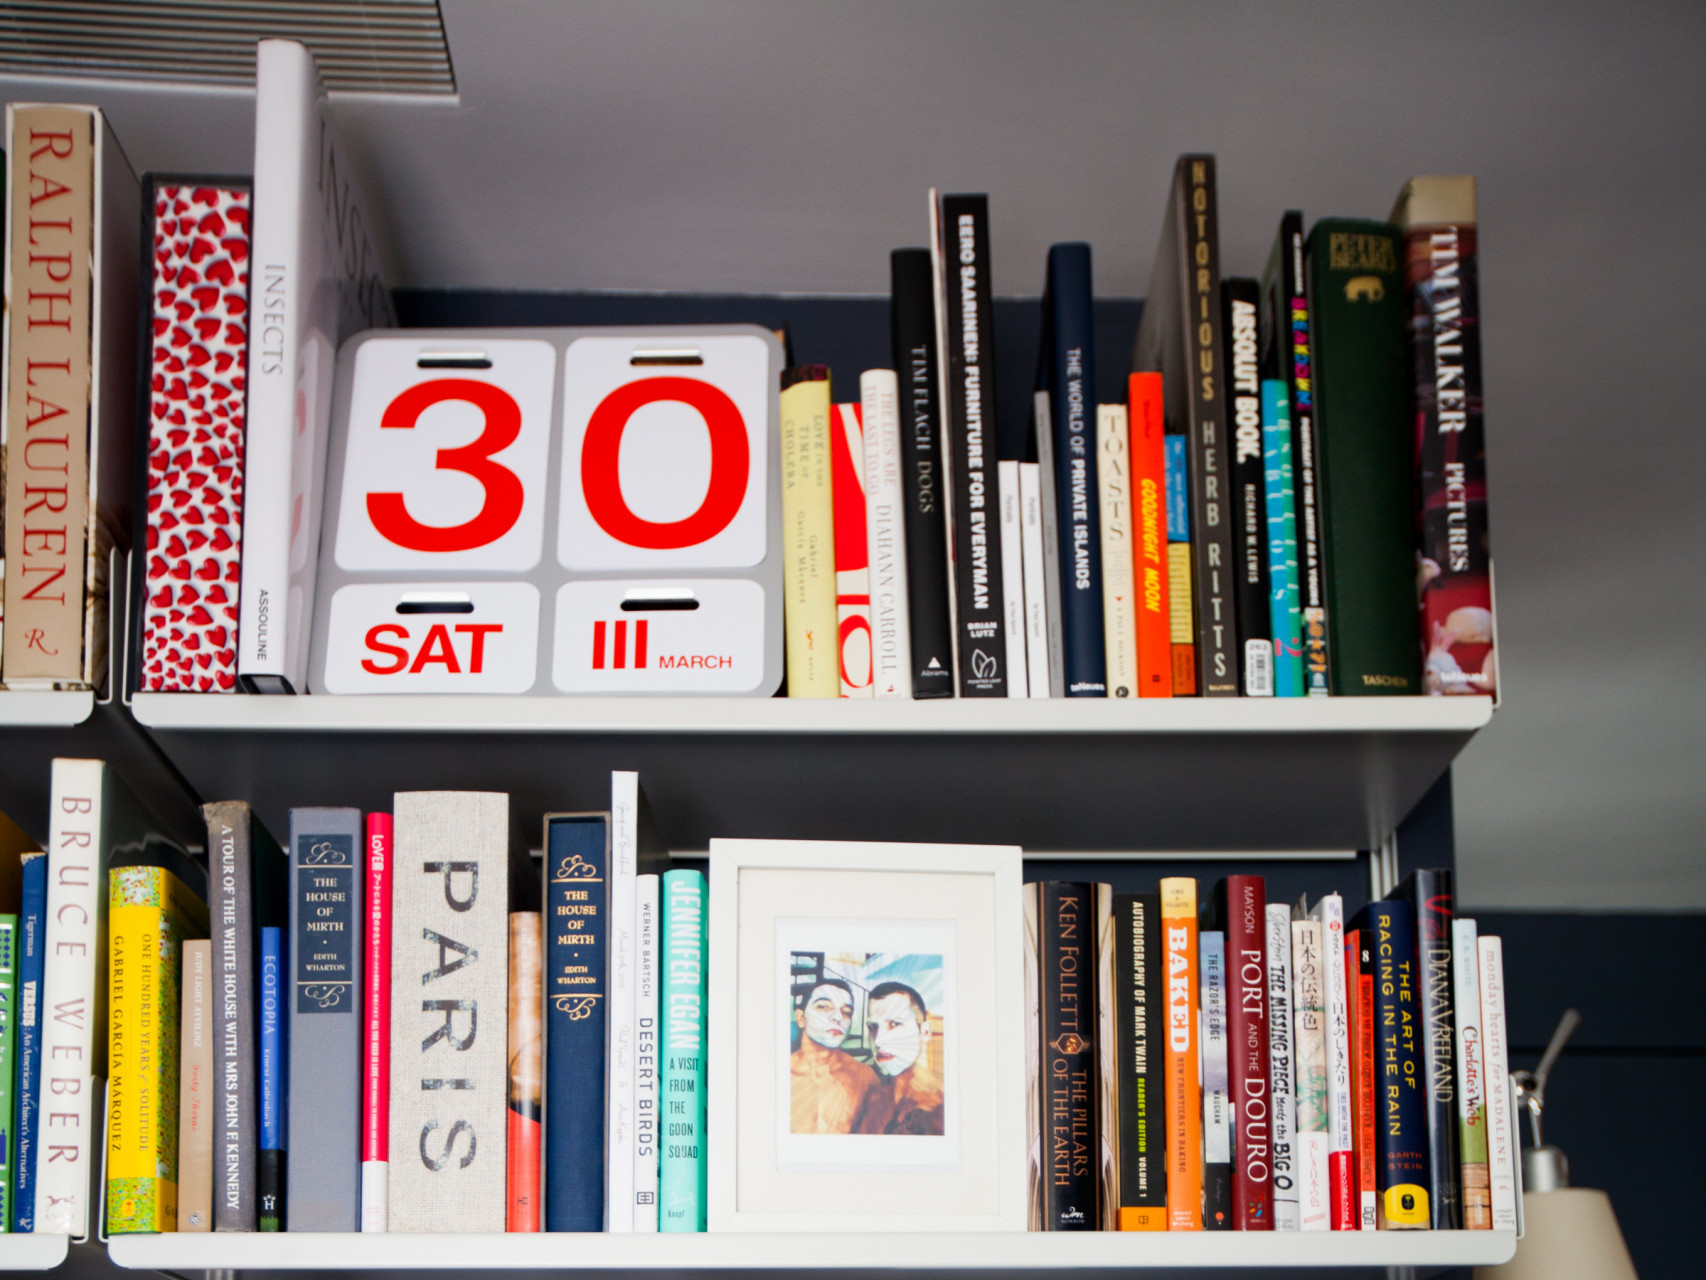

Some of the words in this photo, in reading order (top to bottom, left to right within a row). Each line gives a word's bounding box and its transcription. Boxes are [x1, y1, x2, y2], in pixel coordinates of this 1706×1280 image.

[27, 128, 74, 333] RALPH
[959, 215, 975, 263] EERO
[1429, 227, 1460, 287] TIM
[1192, 160, 1215, 400] NOTORIOUS
[261, 263, 286, 376] INSECTS
[961, 266, 978, 361] SAARINEN:
[911, 345, 927, 383] TIM
[1067, 348, 1082, 377] THE
[1233, 300, 1257, 392] ABSOLUT
[1432, 299, 1466, 434] WALKER
[913, 389, 930, 449] FLACH
[965, 367, 982, 467] FURNITURE
[1068, 380, 1083, 432] WORLD
[1071, 437, 1084, 456] OF
[1236, 397, 1259, 463] BOOK.
[21, 358, 70, 606] LAUREN
[917, 461, 934, 513] DOGS
[969, 472, 985, 507] FOR
[1072, 459, 1087, 520] PRIVATE
[1104, 415, 1123, 541] TOASTS
[1201, 421, 1220, 525] HERB
[1141, 478, 1159, 564] GOODNIGHT
[1444, 462, 1469, 571] PICTURES
[876, 505, 893, 586] DIAHANN
[971, 512, 989, 608] EVERYMAN
[1074, 525, 1090, 589] ISLANDS
[1144, 568, 1160, 612] MOON
[1208, 543, 1227, 676] RITTS
[257, 589, 269, 660] ASSOULINE
[591, 619, 648, 670] III
[659, 655, 734, 669] MARCH
[879, 594, 896, 674] CARROLL
[967, 621, 997, 630] BRIAN
[970, 629, 995, 638] LUTZ
[360, 623, 503, 675] SAT
[921, 668, 949, 676] Abrams
[1362, 675, 1408, 688] TASCHEN
[221, 825, 233, 835] A
[56, 797, 92, 957] BRUCE
[222, 837, 234, 874] TOUR
[223, 877, 234, 894] OF
[564, 890, 588, 900] THE
[223, 898, 235, 924] THE
[557, 905, 596, 915] HOUSE
[568, 921, 585, 930] OF
[642, 902, 651, 946] WERNER
[1059, 896, 1078, 938] KEN
[1244, 887, 1255, 934] MAYSON
[140, 933, 153, 961] ONE
[224, 927, 236, 970] WHITE
[558, 935, 595, 945] MIRTH
[669, 880, 701, 985] JENNIFER
[1132, 901, 1145, 986] AUTOBIOGRAPHY
[113, 935, 124, 1003] GABRIEL
[564, 965, 588, 973] EDITH
[642, 950, 651, 997] BARTSCH
[1208, 954, 1218, 971] THE
[1379, 915, 1396, 996] RACING
[139, 965, 152, 1027] HUNDRED
[224, 974, 237, 1017] HOUSE
[263, 955, 277, 1034] ECOTOPIA
[1060, 946, 1080, 1027] FOLLETT
[1134, 990, 1145, 1002] OF
[1168, 926, 1190, 1053] BAKED
[1209, 974, 1220, 1015] RAZOR'S
[1241, 949, 1264, 1019] PORT
[1270, 965, 1285, 992] THE
[1301, 930, 1318, 1032] 日本の伝統色
[1399, 961, 1412, 1003] THE
[1428, 949, 1452, 1009] DIANA
[419, 861, 479, 1172] PARIS
[669, 994, 701, 1049] EGAN
[1134, 1006, 1146, 1037] MARK
[1210, 1018, 1220, 1041] EDGE
[1248, 1023, 1258, 1048] AND
[1271, 996, 1288, 1050] MISSING
[1383, 1005, 1396, 1024] IN
[1401, 1010, 1414, 1050] ART
[112, 1009, 127, 1068] GARCÍA
[139, 1032, 151, 1070] YEARS
[225, 1021, 237, 1056] WITH
[638, 1018, 654, 1091] DESERT
[1135, 1039, 1146, 1073] TWAIN
[1332, 1002, 1346, 1085] 日本のしきたり
[1385, 1034, 1398, 1076] THE
[1430, 1006, 1454, 1101] VREELAND
[1462, 1026, 1479, 1094] Charlotte's
[48, 998, 85, 1162] WEBER
[137, 1073, 150, 1084] of
[225, 1061, 237, 1090] MRS
[670, 1058, 677, 1071] A
[680, 1058, 699, 1071] VISIT
[1053, 1059, 1068, 1085] OF
[1249, 1051, 1259, 1072] THE
[1272, 1055, 1289, 1094] PIECE
[1403, 1061, 1415, 1089] OF
[669, 1079, 695, 1092] FROM
[669, 1101, 686, 1114] THE
[1054, 1089, 1068, 1122] THE
[1071, 1069, 1087, 1104] THE
[1137, 1077, 1146, 1116] READER'S
[1212, 1090, 1221, 1124] MAUGHAM
[110, 1074, 125, 1152] MÁRQUEZ
[138, 1088, 150, 1151] SOLITUDE
[225, 1093, 238, 1127] JOHN
[638, 1100, 653, 1157] BIRDS
[669, 1123, 693, 1136] GOON
[1244, 1077, 1268, 1183] DOURO
[1275, 1097, 1287, 1121] Meets
[1388, 1085, 1401, 1135] RAIN
[1466, 1097, 1480, 1125] Web
[226, 1131, 238, 1141] F.
[669, 1145, 698, 1158] SQUAD
[1072, 1108, 1088, 1176] PILLARS
[1138, 1119, 1146, 1151] EDITION
[1277, 1124, 1287, 1140] the
[226, 1144, 239, 1209] KENNEDY
[1054, 1126, 1069, 1185] EARTH
[1139, 1156, 1147, 1190] VOLUME
[1274, 1143, 1291, 1170] BIG
[1275, 1175, 1292, 1190] O
